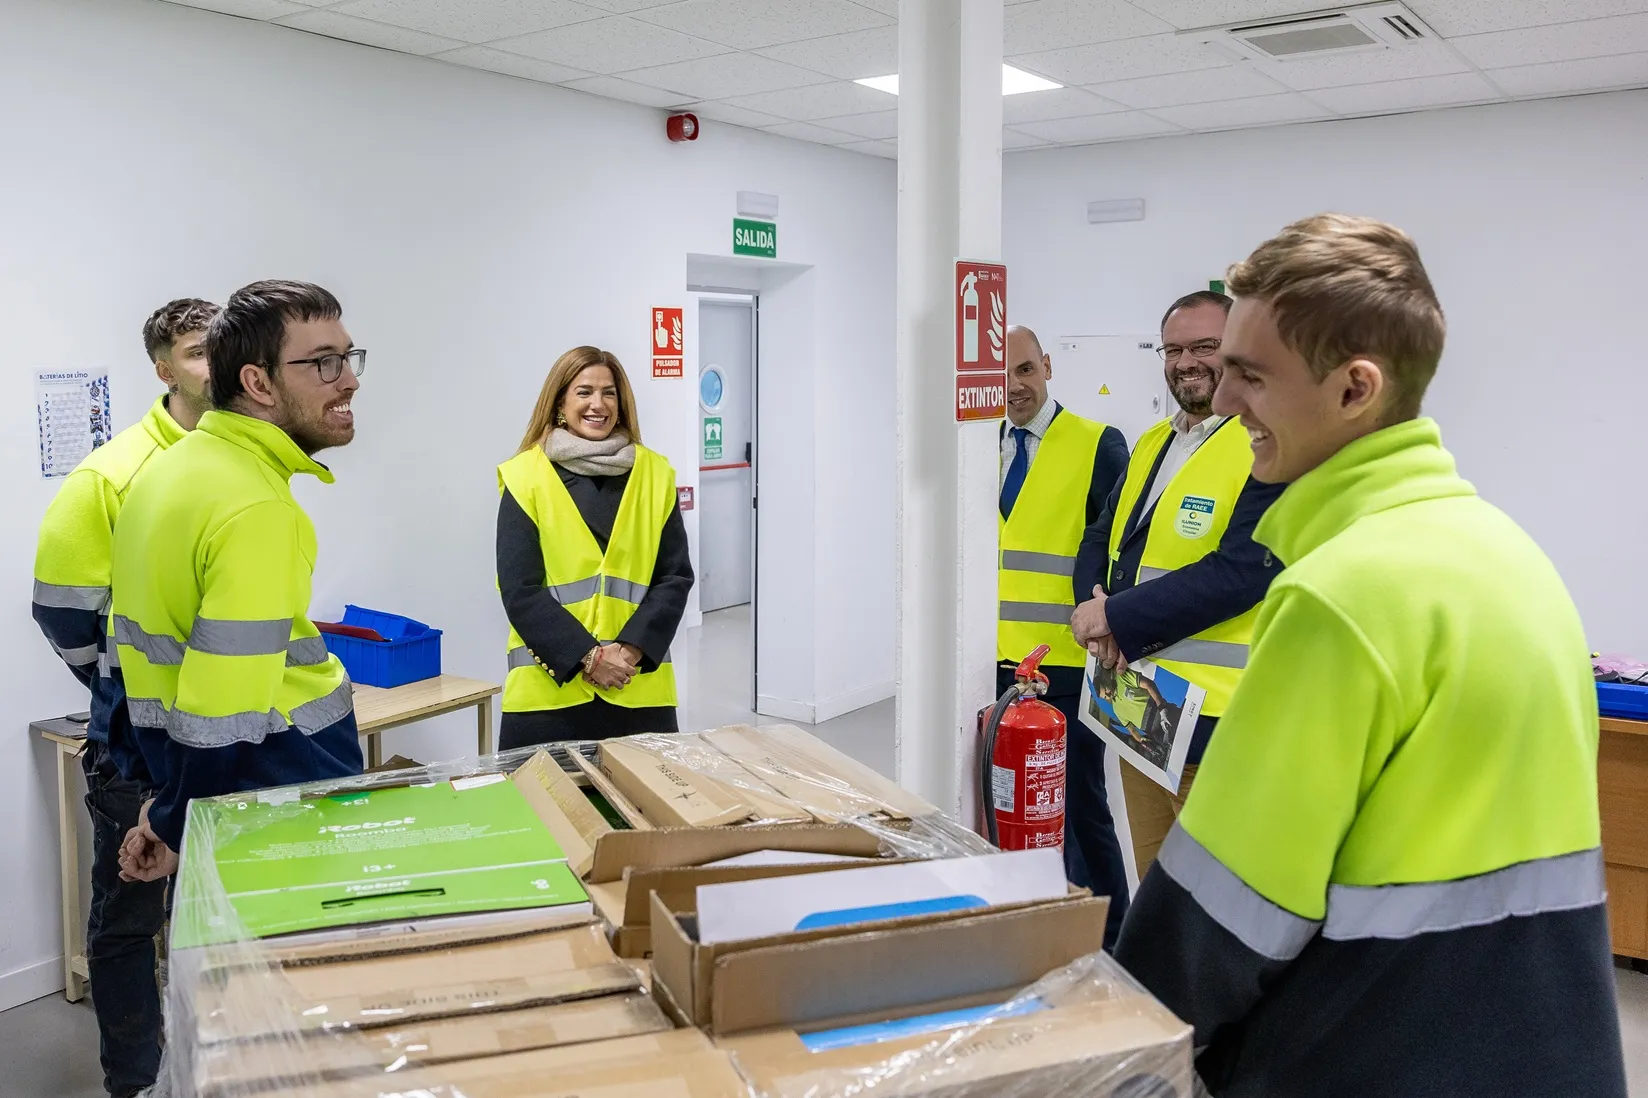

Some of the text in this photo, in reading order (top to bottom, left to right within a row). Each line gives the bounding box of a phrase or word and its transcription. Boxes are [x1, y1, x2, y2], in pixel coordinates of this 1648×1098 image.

[735, 227, 774, 249] SALIDA
[959, 386, 1004, 409] EXTINTOR
[318, 816, 416, 834] iRobot
[336, 827, 406, 838] Roomba
[362, 864, 396, 872] i3+
[346, 880, 411, 892] iRobot
